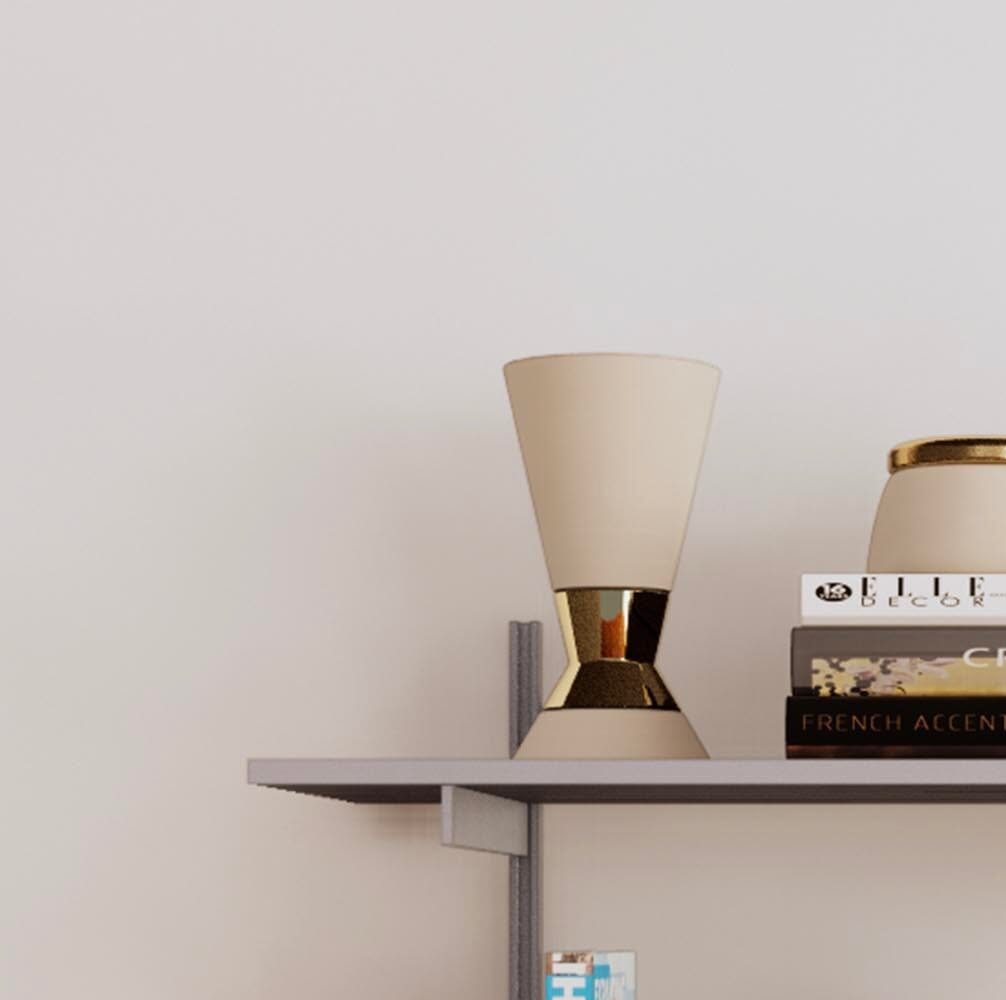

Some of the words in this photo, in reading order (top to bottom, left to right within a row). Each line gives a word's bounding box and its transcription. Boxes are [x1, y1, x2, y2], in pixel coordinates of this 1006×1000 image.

[861, 577, 985, 597] ELLE
[861, 596, 985, 607] DECOR
[802, 713, 900, 731] FRENCH
